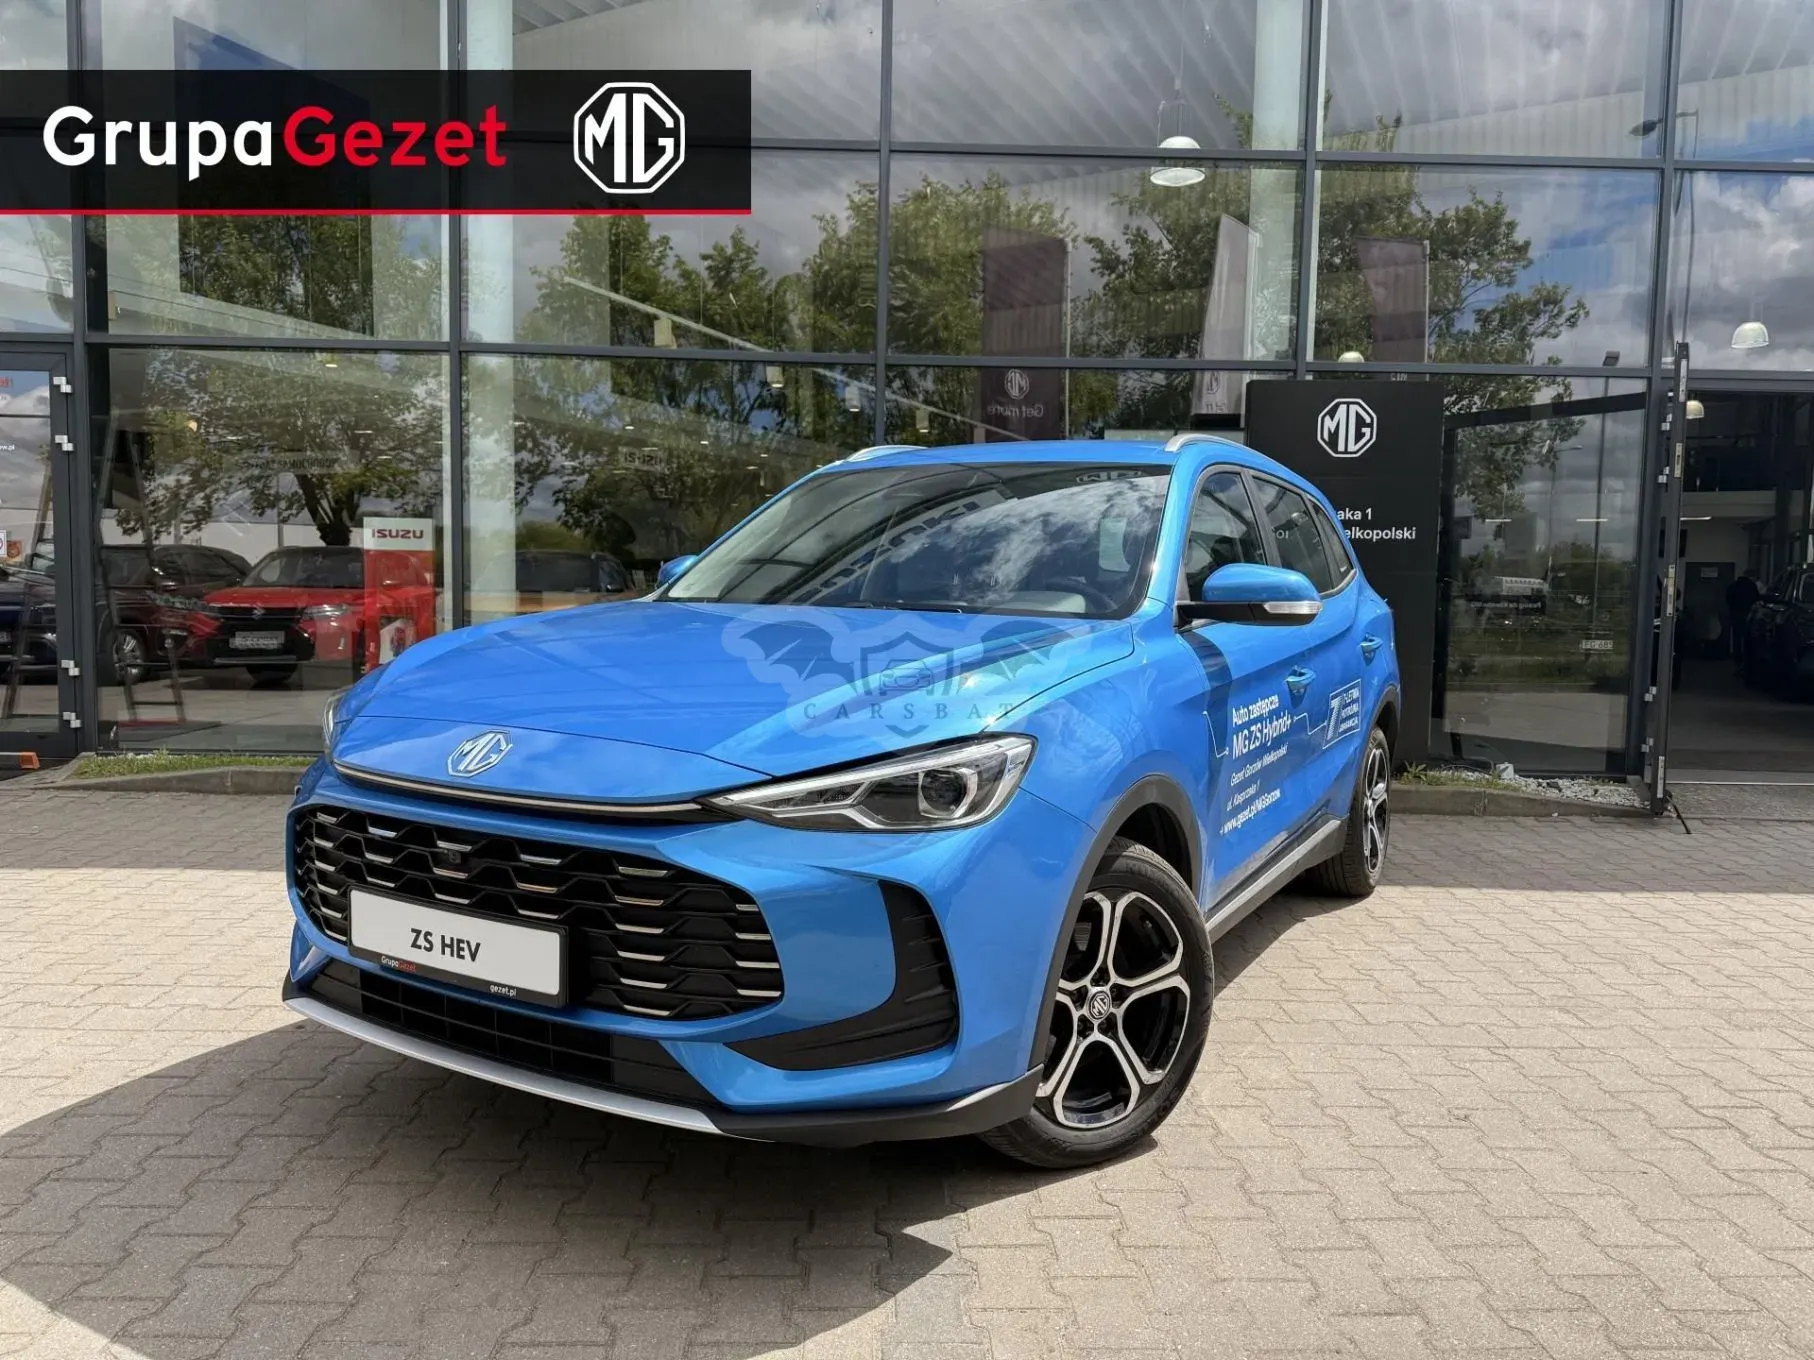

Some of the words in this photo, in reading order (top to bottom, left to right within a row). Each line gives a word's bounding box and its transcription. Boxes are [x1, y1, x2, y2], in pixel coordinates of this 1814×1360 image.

[1323, 403, 1372, 453] MG
[1366, 508, 1373, 520] 1
[371, 528, 425, 540] ISUZU
[1232, 706, 1248, 727] Auto
[1249, 694, 1279, 724] zastępcze
[452, 732, 508, 773] MG
[1232, 731, 1249, 760] MG
[1250, 724, 1262, 749] ZS
[410, 928, 434, 952] ZS
[440, 935, 481, 962] HEV
[489, 984, 517, 998] gezet.pl
